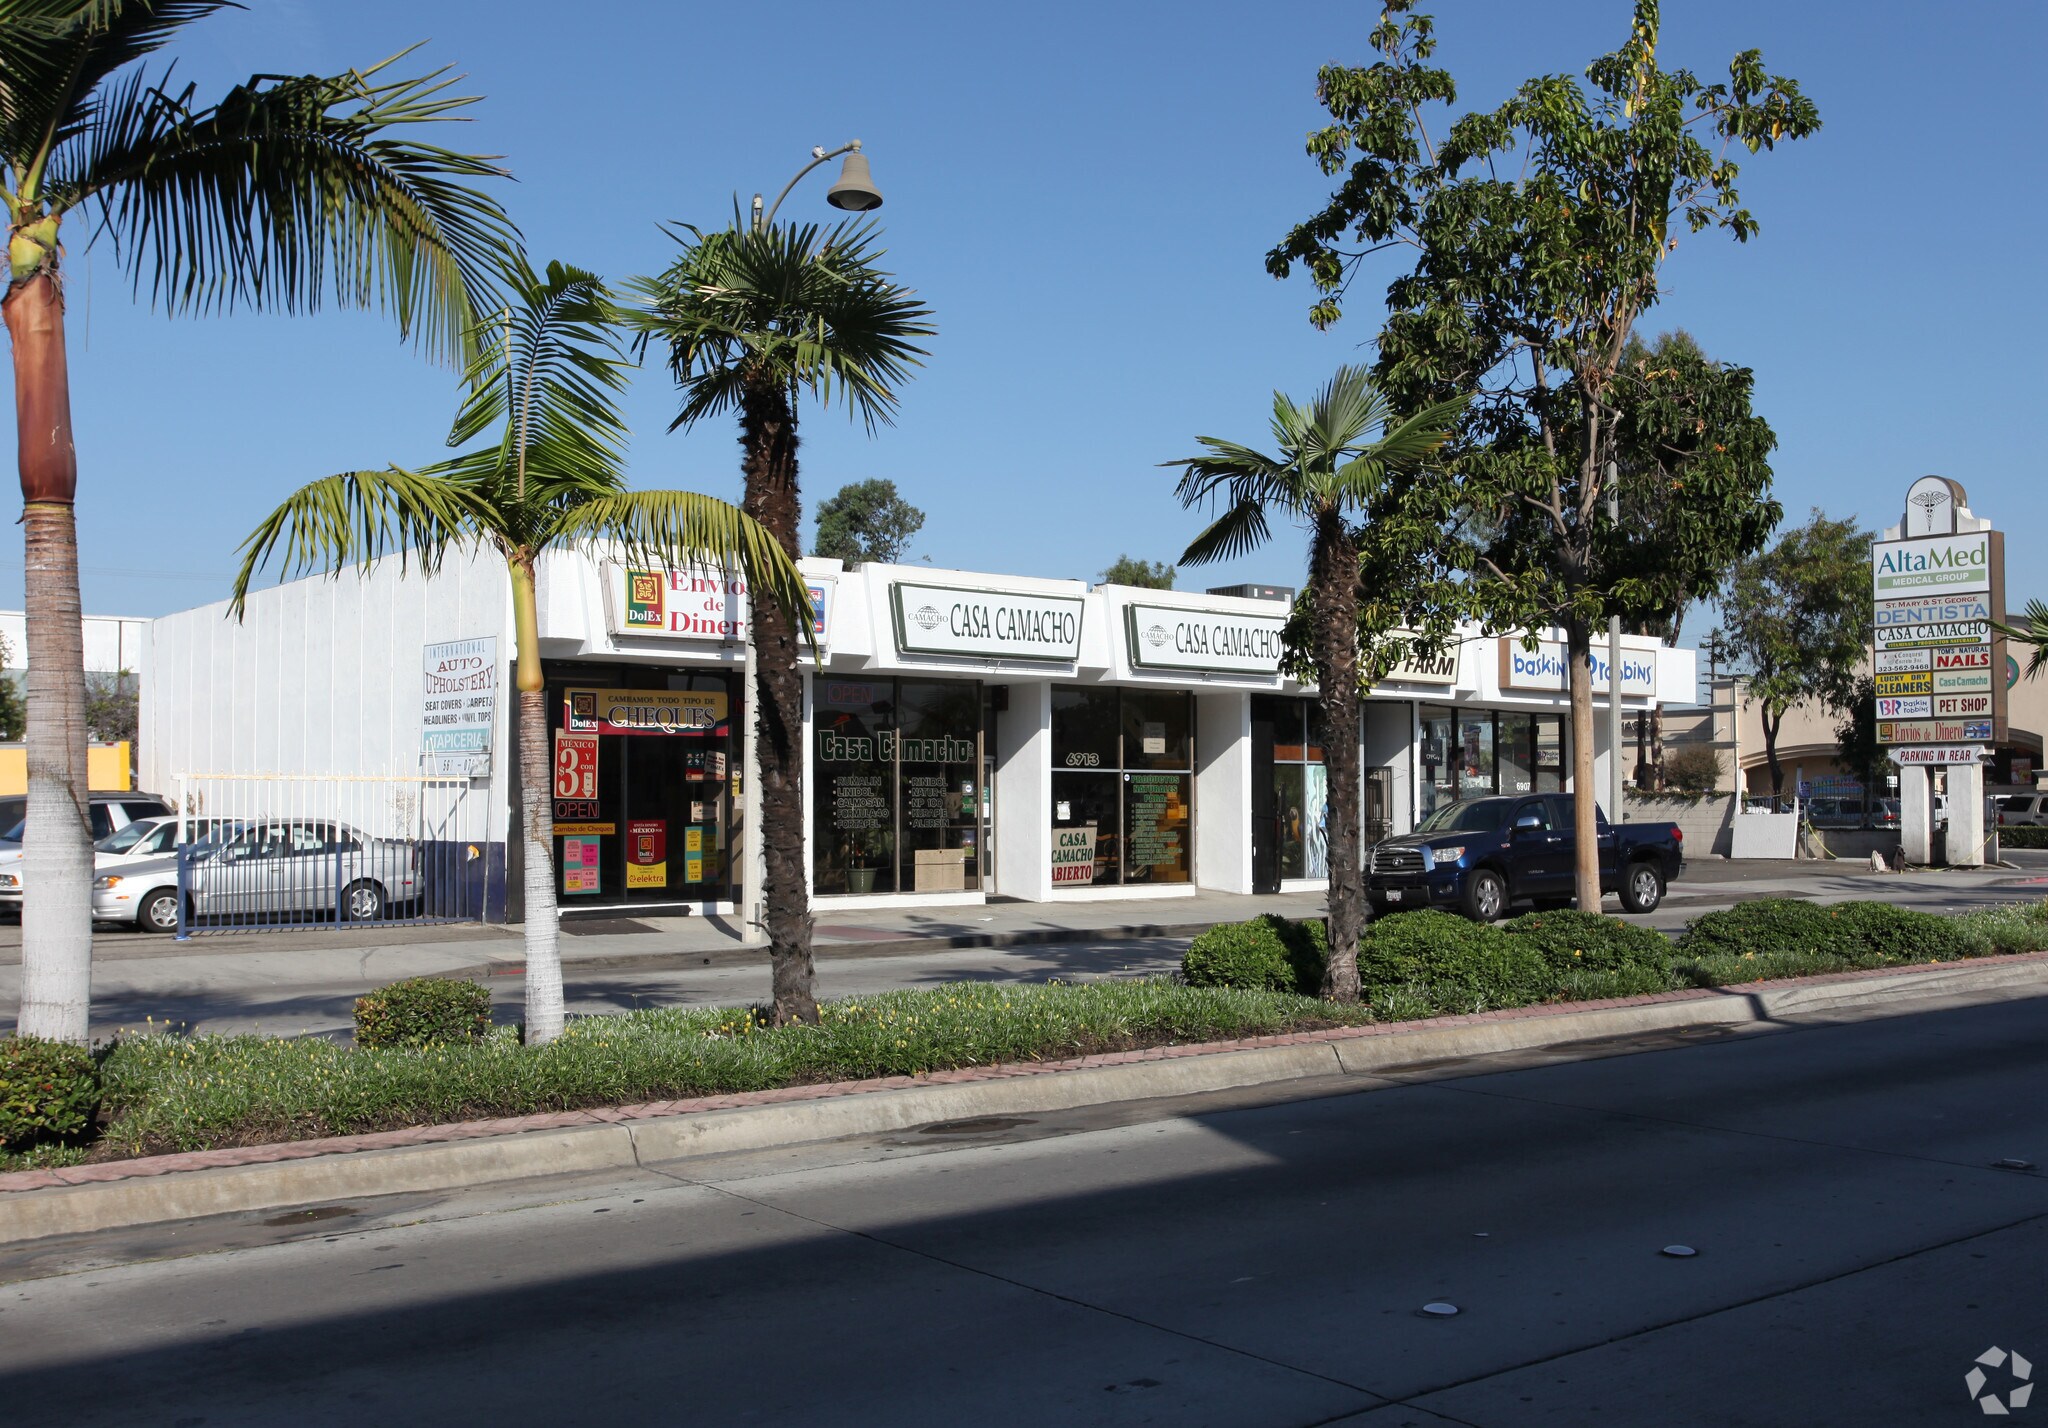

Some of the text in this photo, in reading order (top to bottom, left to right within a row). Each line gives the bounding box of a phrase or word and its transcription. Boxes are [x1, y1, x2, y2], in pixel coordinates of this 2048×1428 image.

[1878, 540, 1986, 575] AltaMed
[1892, 572, 1970, 587] MEDICAL GROUP
[703, 597, 724, 612] de
[1898, 599, 1921, 608] MARY
[1931, 598, 1943, 606] ST.
[1944, 596, 1978, 605] GEORGE
[628, 609, 662, 622] DolEx
[908, 612, 949, 623] CAMACHO
[1876, 603, 1989, 625] DENTISTA
[669, 611, 747, 636] Diner
[950, 603, 1075, 644] CASA CAMACHO
[1140, 630, 1174, 641] CAMACHO
[1877, 621, 1989, 642] CASA CAMACHO
[1175, 622, 1280, 660] CASA CAMACHO
[1958, 646, 1988, 654] NATURAL
[437, 657, 483, 673] AUTO
[1404, 656, 1455, 676] FARM
[1513, 653, 1566, 679] baskin
[1936, 653, 1989, 668] NAILS
[1878, 664, 1930, 673] 323-562-9468
[425, 665, 494, 694] UPHOLSTERY
[1880, 673, 1927, 683] LUCKY DRY
[1939, 675, 1988, 687] Casa Camacho
[830, 685, 873, 703] OPEN
[1876, 681, 1931, 695] CLEANERS
[424, 700, 440, 711] SEAT
[441, 698, 463, 710] COVERS
[657, 696, 680, 704] TODO
[683, 697, 702, 705] TIPO
[1903, 699, 1928, 707] baskin
[1939, 697, 1988, 714] PET SHOP
[1879, 699, 1902, 716] BR
[1903, 706, 1929, 714] robbins
[424, 713, 458, 725] HEADLINERS
[478, 711, 491, 722] TOPS
[571, 719, 597, 729] DolEx
[607, 704, 716, 734] CHEQUES
[1923, 729, 1931, 741] de
[1934, 721, 1963, 740] Dinero
[432, 732, 483, 749] TAPICERIA
[560, 739, 595, 749] MÉXICO
[818, 729, 970, 763] Casa Camacho
[585, 753, 592, 761] Y
[1065, 752, 1100, 767] 6913
[1899, 749, 1972, 762] PARKING IN REAR
[580, 763, 594, 771] con
[837, 776, 882, 787] RUMALIN
[911, 776, 948, 787] RINIDOL
[1131, 775, 1180, 784] PRODUCTOS
[837, 787, 875, 797] LINIDOL
[1132, 784, 1178, 793] NATURALES
[1516, 782, 1531, 791] 6907
[837, 797, 885, 808] CALMOSAN
[911, 798, 944, 808] NP 100
[557, 802, 598, 817] OPEN
[553, 824, 578, 832] Cambio
[587, 824, 613, 833] Cheques
[1060, 832, 1088, 847] CASA
[1052, 848, 1094, 864] CAMACHO
[637, 874, 664, 883] elektra
